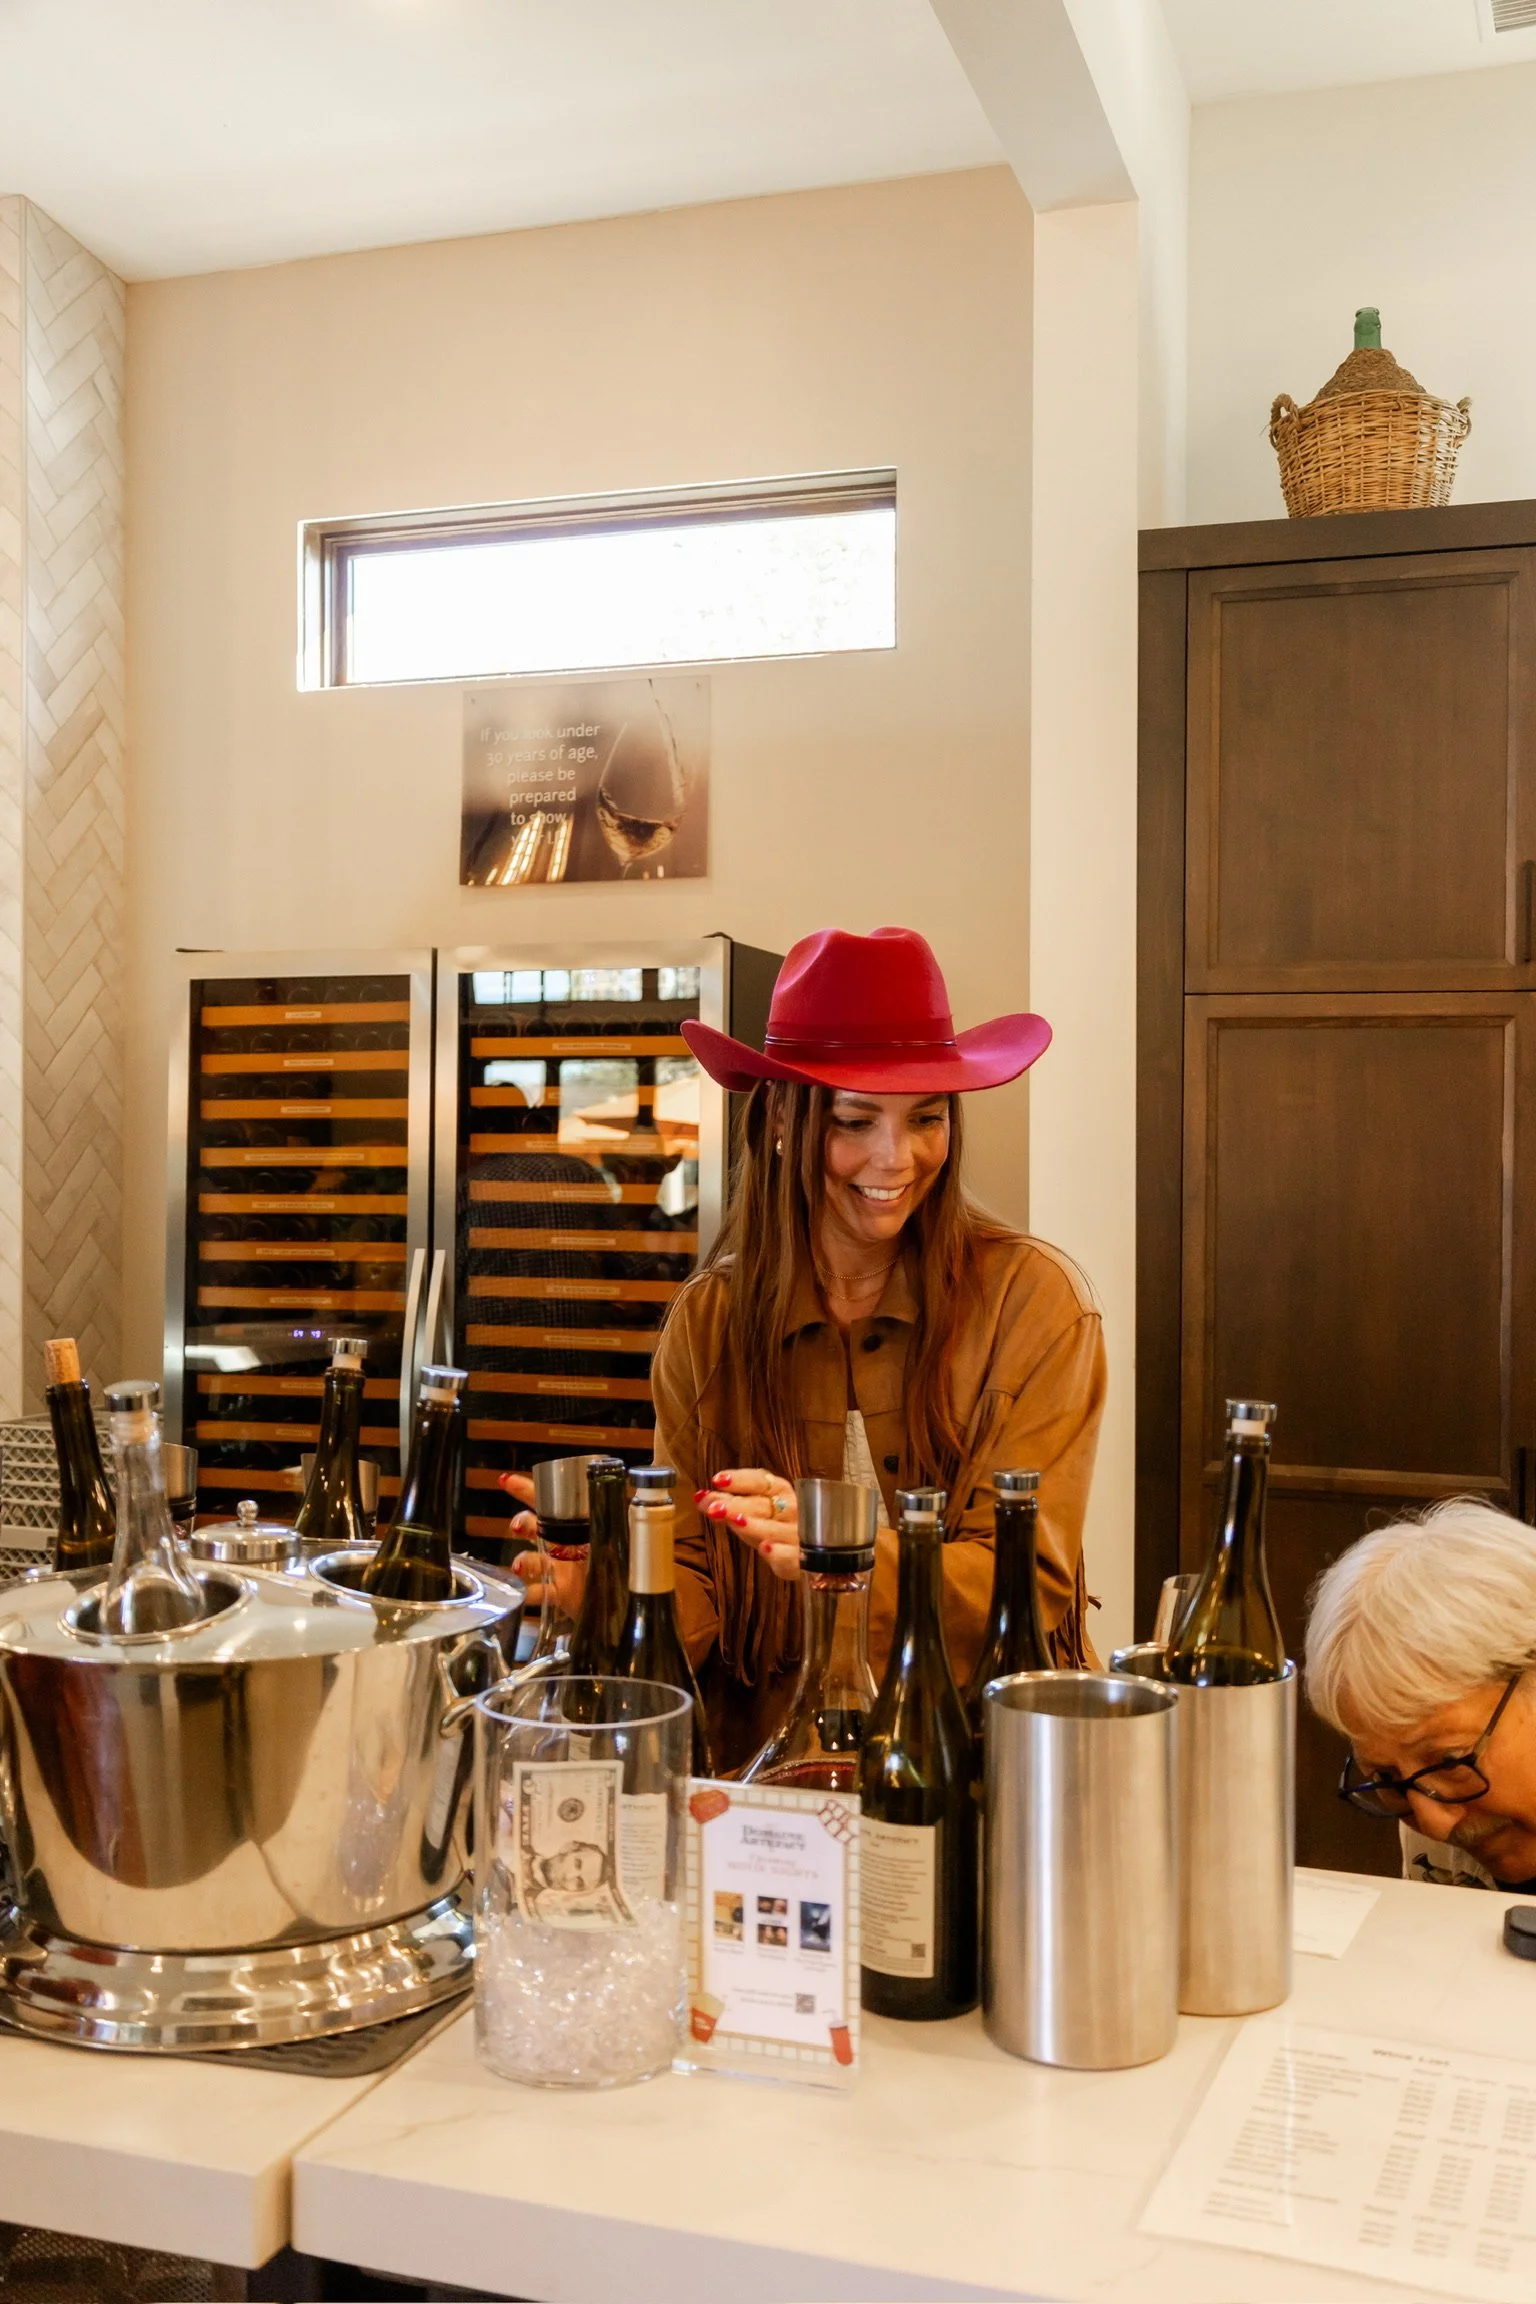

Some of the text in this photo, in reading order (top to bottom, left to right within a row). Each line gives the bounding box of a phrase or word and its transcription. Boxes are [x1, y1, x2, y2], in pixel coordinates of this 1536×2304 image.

[480, 728, 490, 741] If
[494, 731, 517, 744] you
[557, 723, 600, 737] under
[486, 744, 598, 766] 30 years of age,
[507, 767, 575, 784] please be
[509, 787, 576, 807] prepared
[510, 813, 525, 825] to
